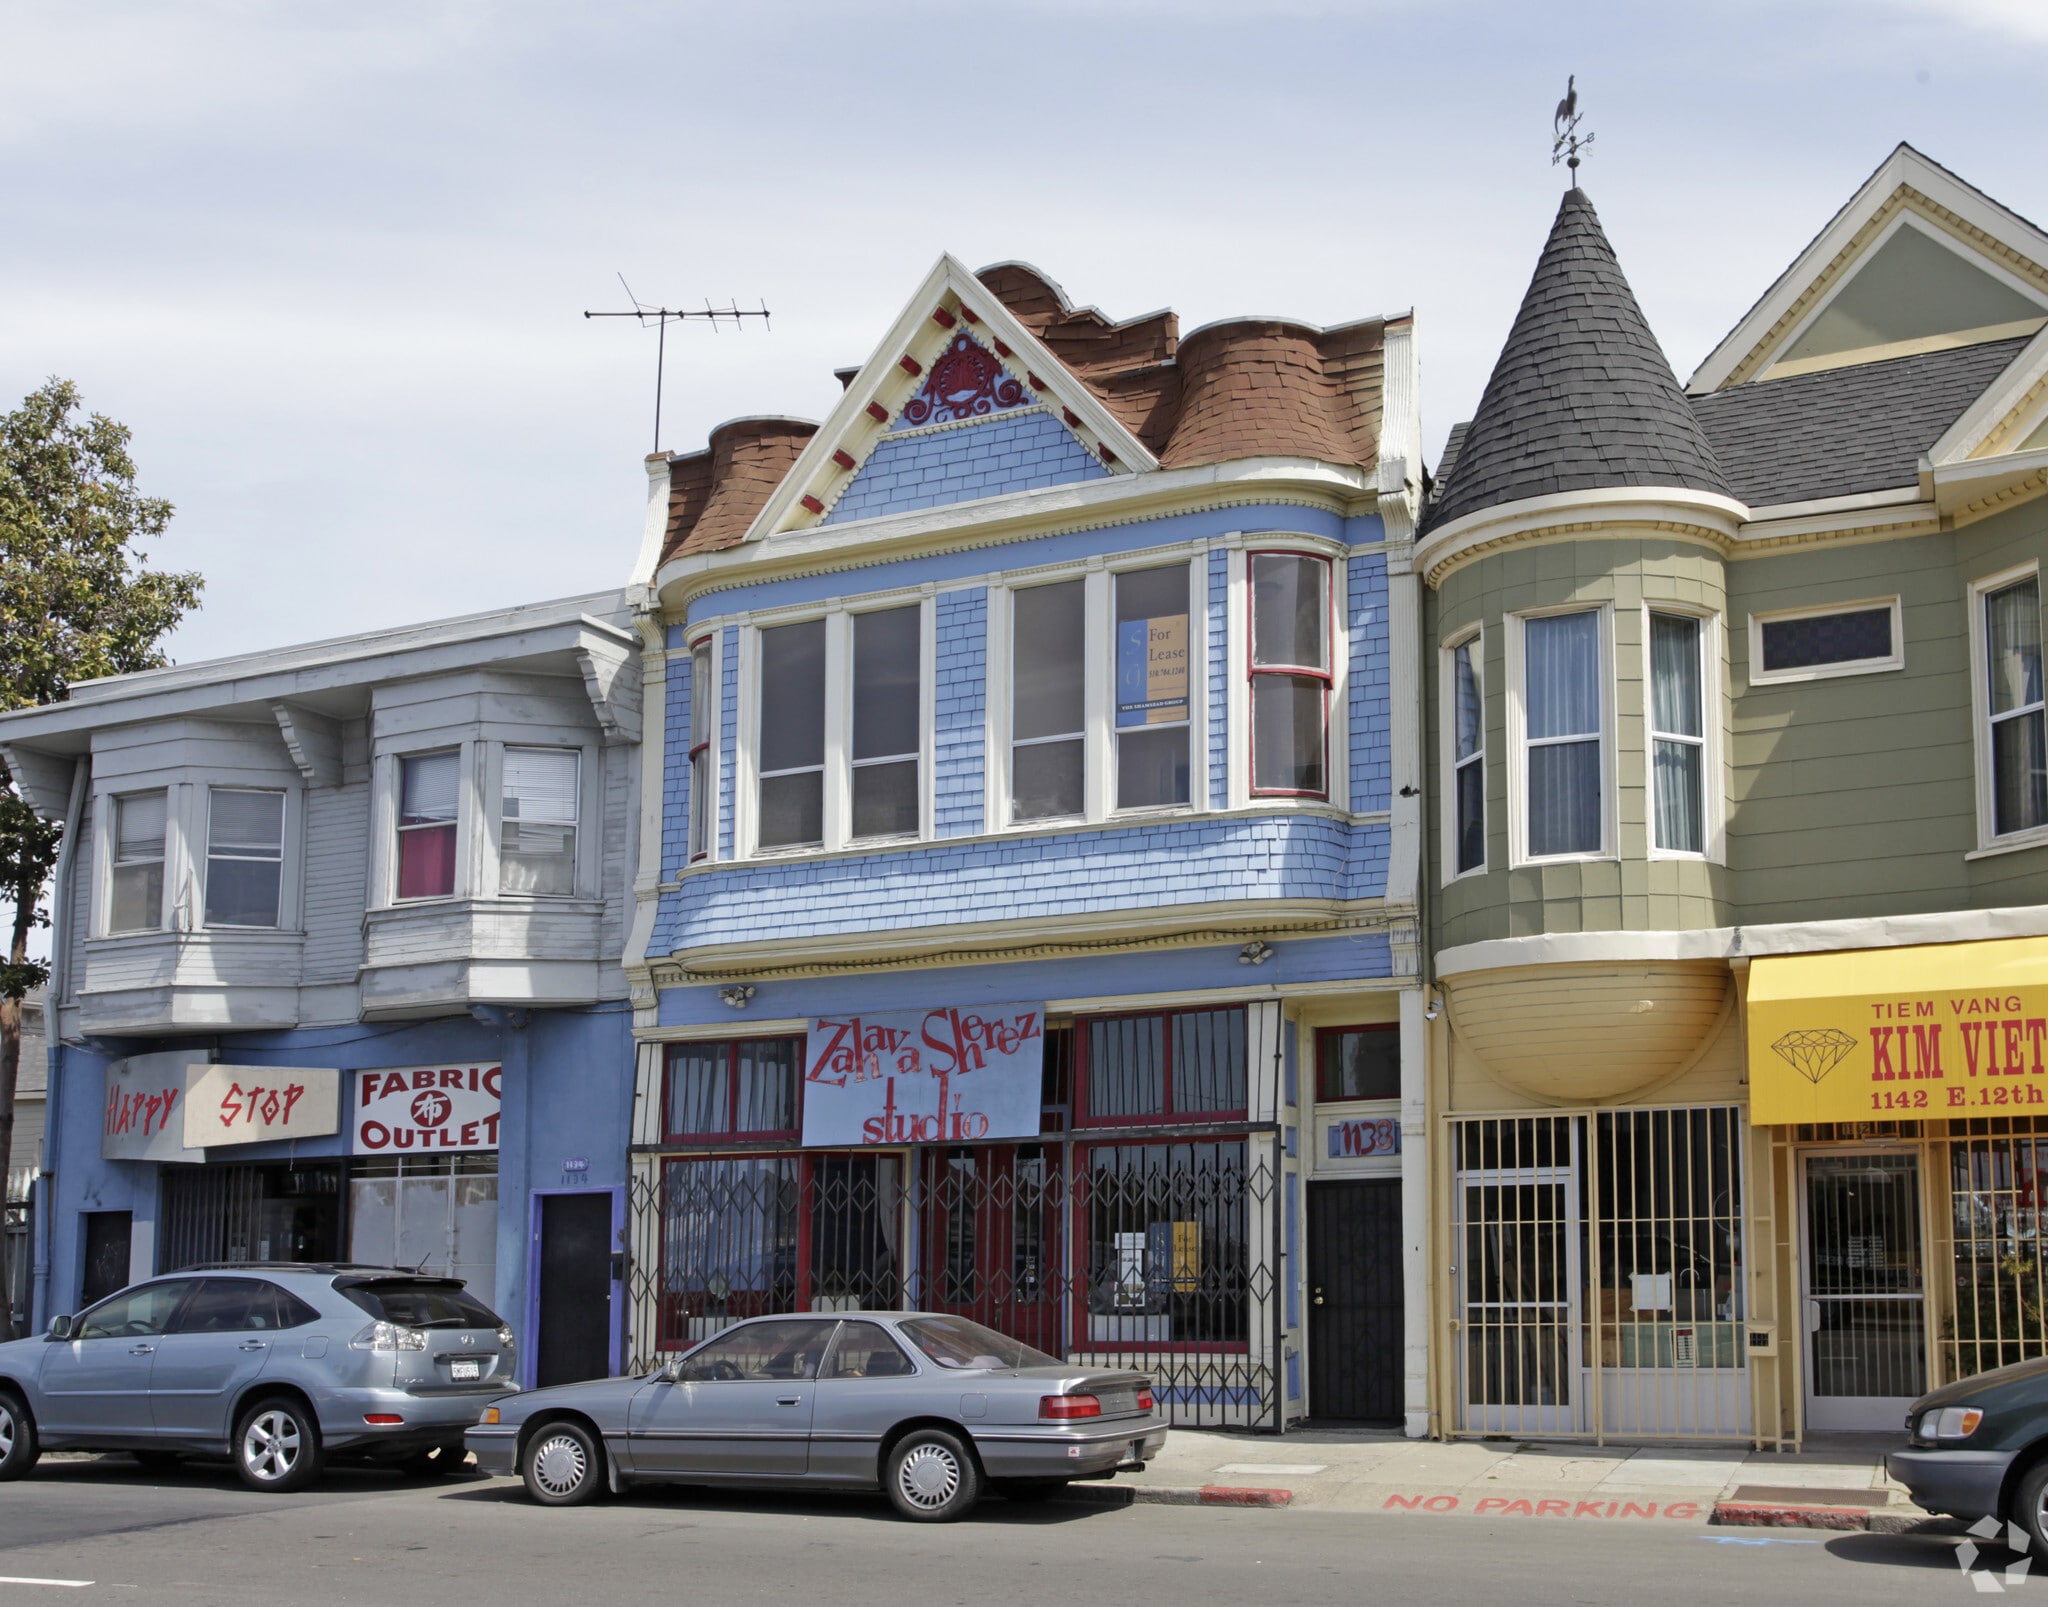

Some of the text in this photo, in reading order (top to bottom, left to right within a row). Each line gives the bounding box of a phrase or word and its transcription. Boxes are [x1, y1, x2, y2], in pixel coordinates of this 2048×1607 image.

[1149, 628, 1171, 642] For
[1148, 647, 1186, 662] Lease
[1871, 995, 2022, 1019] TIEM VANG
[1869, 1018, 2048, 1082] KIM VIET
[219, 1082, 305, 1128] STOP
[413, 1093, 449, 1127] 布
[862, 1072, 990, 1145] studio
[1871, 1089, 1929, 1110] 1142
[360, 1111, 501, 1150] OUTLET
[1341, 1118, 1394, 1155] 1138
[1381, 1494, 1703, 1519] NO PARKING
